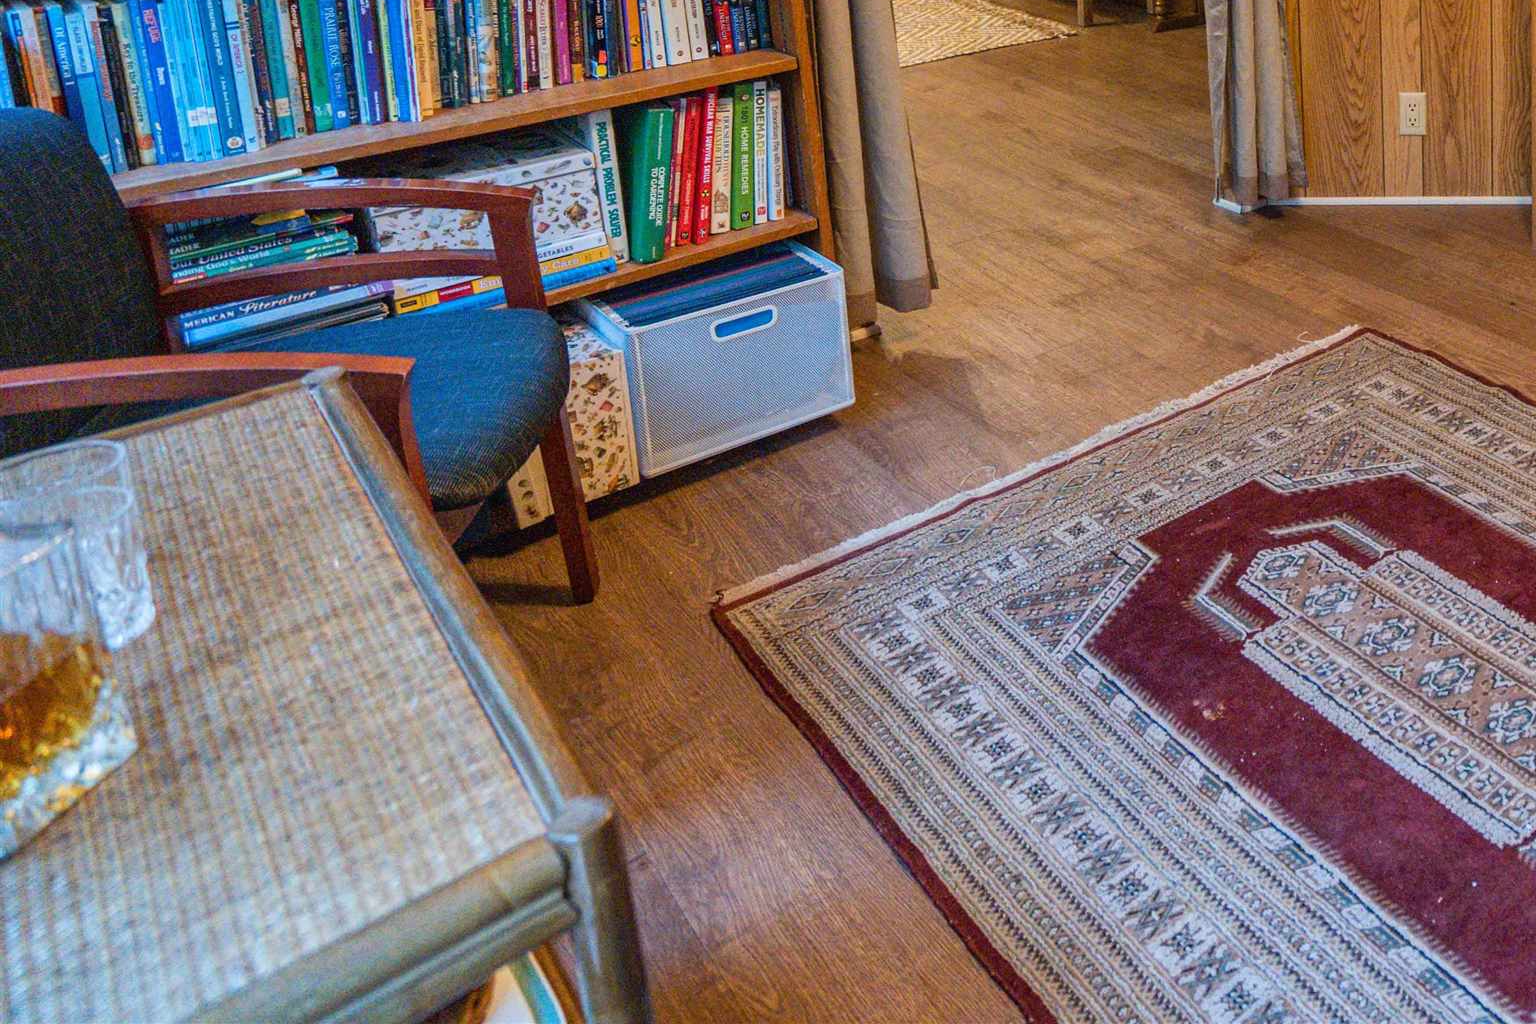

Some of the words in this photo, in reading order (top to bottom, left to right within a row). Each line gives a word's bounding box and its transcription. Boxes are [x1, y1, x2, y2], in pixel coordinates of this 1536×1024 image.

[325, 7, 338, 44] PRAIRIE
[327, 46, 341, 68] ROSE
[706, 94, 714, 119] NUCLEAR
[755, 88, 766, 158] HOMEMADE
[595, 121, 612, 164] PRACTICAL
[704, 136, 712, 163] SURVIVAL
[740, 126, 749, 152] HOME
[601, 167, 616, 206] PROBLEM
[651, 167, 658, 178] TO
[656, 166, 665, 203] COMPLETE
[702, 164, 711, 183] SKILLS
[740, 154, 749, 195] REMEDIES
[649, 179, 658, 219] GARDENING
[611, 208, 622, 239] SOLVER
[656, 204, 664, 226] GUIDE
[538, 245, 574, 259] GETABLES
[184, 311, 235, 329] MERICAN
[240, 290, 317, 314] Literature
